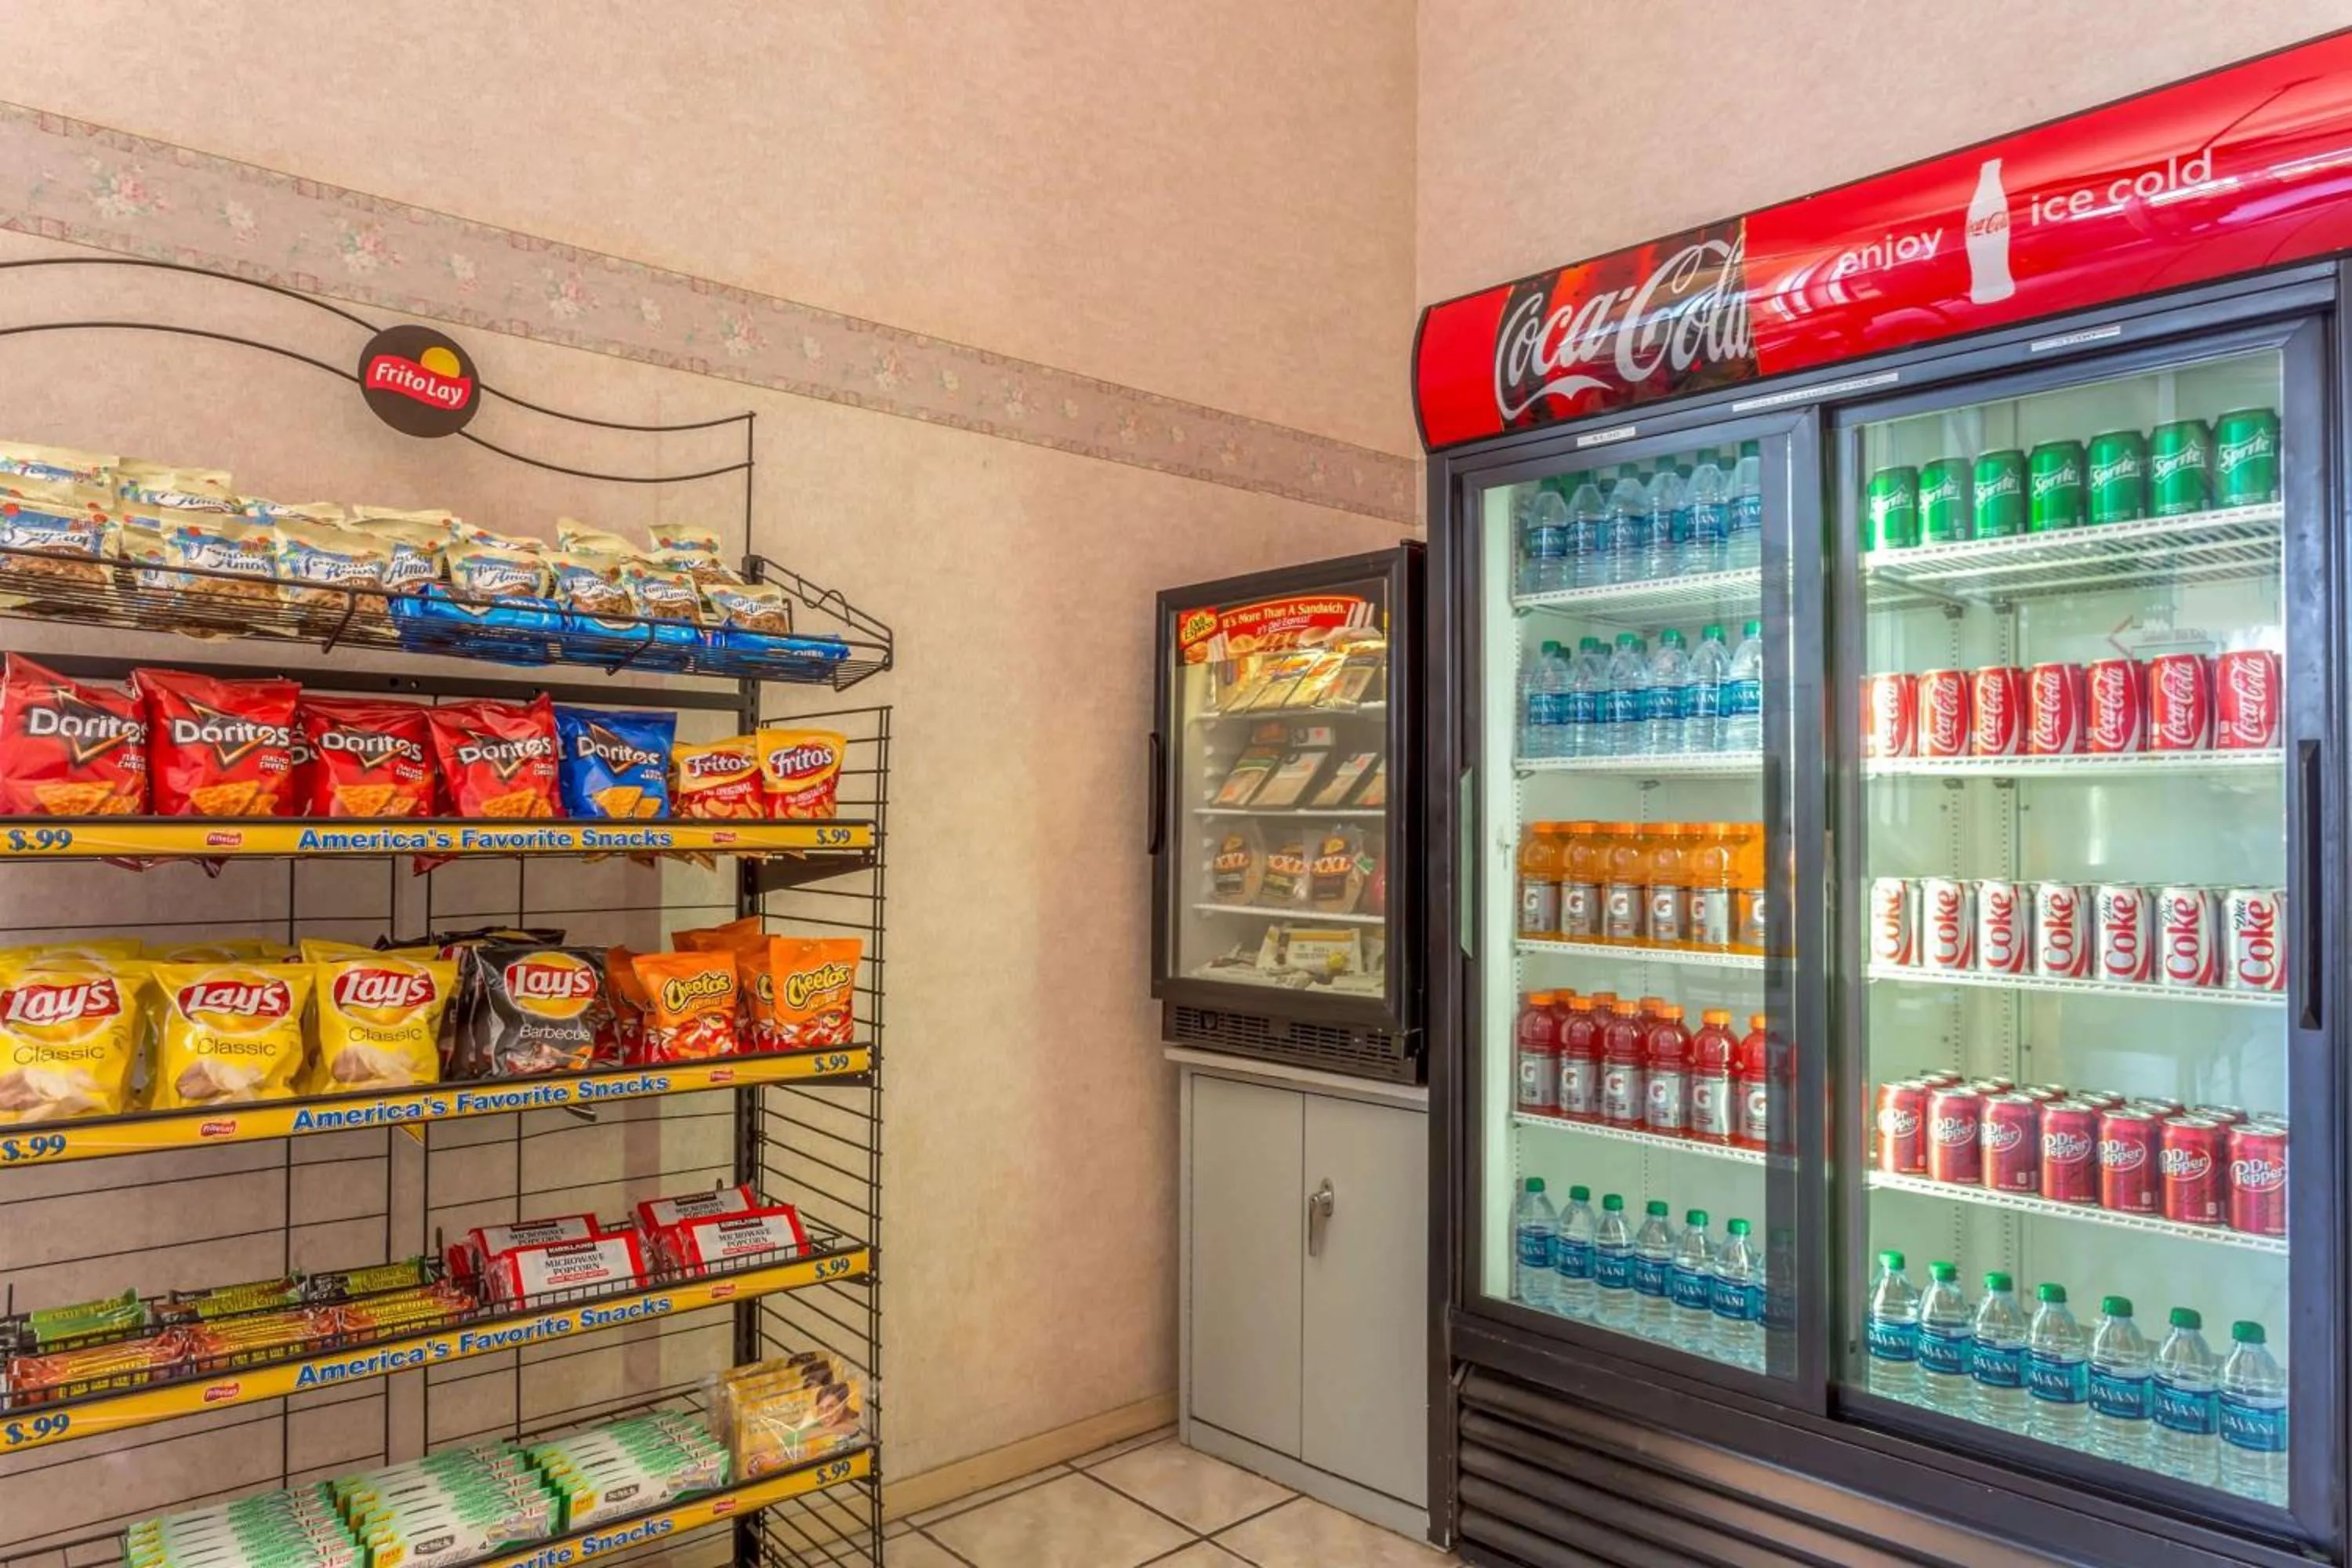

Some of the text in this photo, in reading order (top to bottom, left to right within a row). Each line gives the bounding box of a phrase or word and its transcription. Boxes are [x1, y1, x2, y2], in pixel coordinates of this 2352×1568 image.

[2031, 148, 2212, 226] ice cold
[1838, 228, 1943, 275] enjoy
[1495, 238, 1753, 420] Coca-Cola
[1264, 608, 1287, 619] Than
[1288, 604, 1295, 615] A
[29, 707, 149, 744] Doritos
[174, 718, 290, 746] Doritos
[322, 732, 423, 762] Doritos
[459, 736, 552, 764] Doritos
[577, 736, 661, 765] Doritos
[769, 746, 833, 777] Fritos
[684, 753, 751, 779] Fritos
[8, 829, 73, 851] $.99
[299, 828, 673, 850] America's Favorite Snacks
[816, 829, 852, 845] $.99
[1933, 889, 1958, 964] Coke
[1985, 891, 2013, 967] Coke
[2044, 893, 2074, 971] Coke
[2105, 895, 2137, 975] Coke
[2165, 897, 2200, 979] Coke
[2238, 899, 2274, 985] Coke
[185, 981, 286, 1014] Lay's
[341, 965, 428, 1007] Lay's
[514, 965, 591, 1000] Lay's
[665, 973, 731, 1012] Cheetos
[788, 965, 849, 1008] Cheetos
[5, 978, 113, 1025] Lay's
[197, 1037, 277, 1056] Classic
[348, 1026, 423, 1042] Classic
[520, 1025, 591, 1042] Barbecue
[13, 1045, 105, 1065] Classic
[815, 1054, 849, 1073] $.99
[293, 1074, 670, 1131] America's Favorite Snacks
[2, 1134, 67, 1161] $.99
[2172, 1149, 2193, 1162] Dr
[2234, 1160, 2285, 1185] Pepper
[2250, 1158, 2272, 1171] Dr
[545, 1252, 604, 1269] MICROWAVE
[815, 1257, 851, 1280] $.99
[296, 1295, 673, 1388] America's Favorite Snacks
[5, 1413, 71, 1446] $.99
[816, 1460, 851, 1486] $.99
[582, 1517, 673, 1556] Snacks
